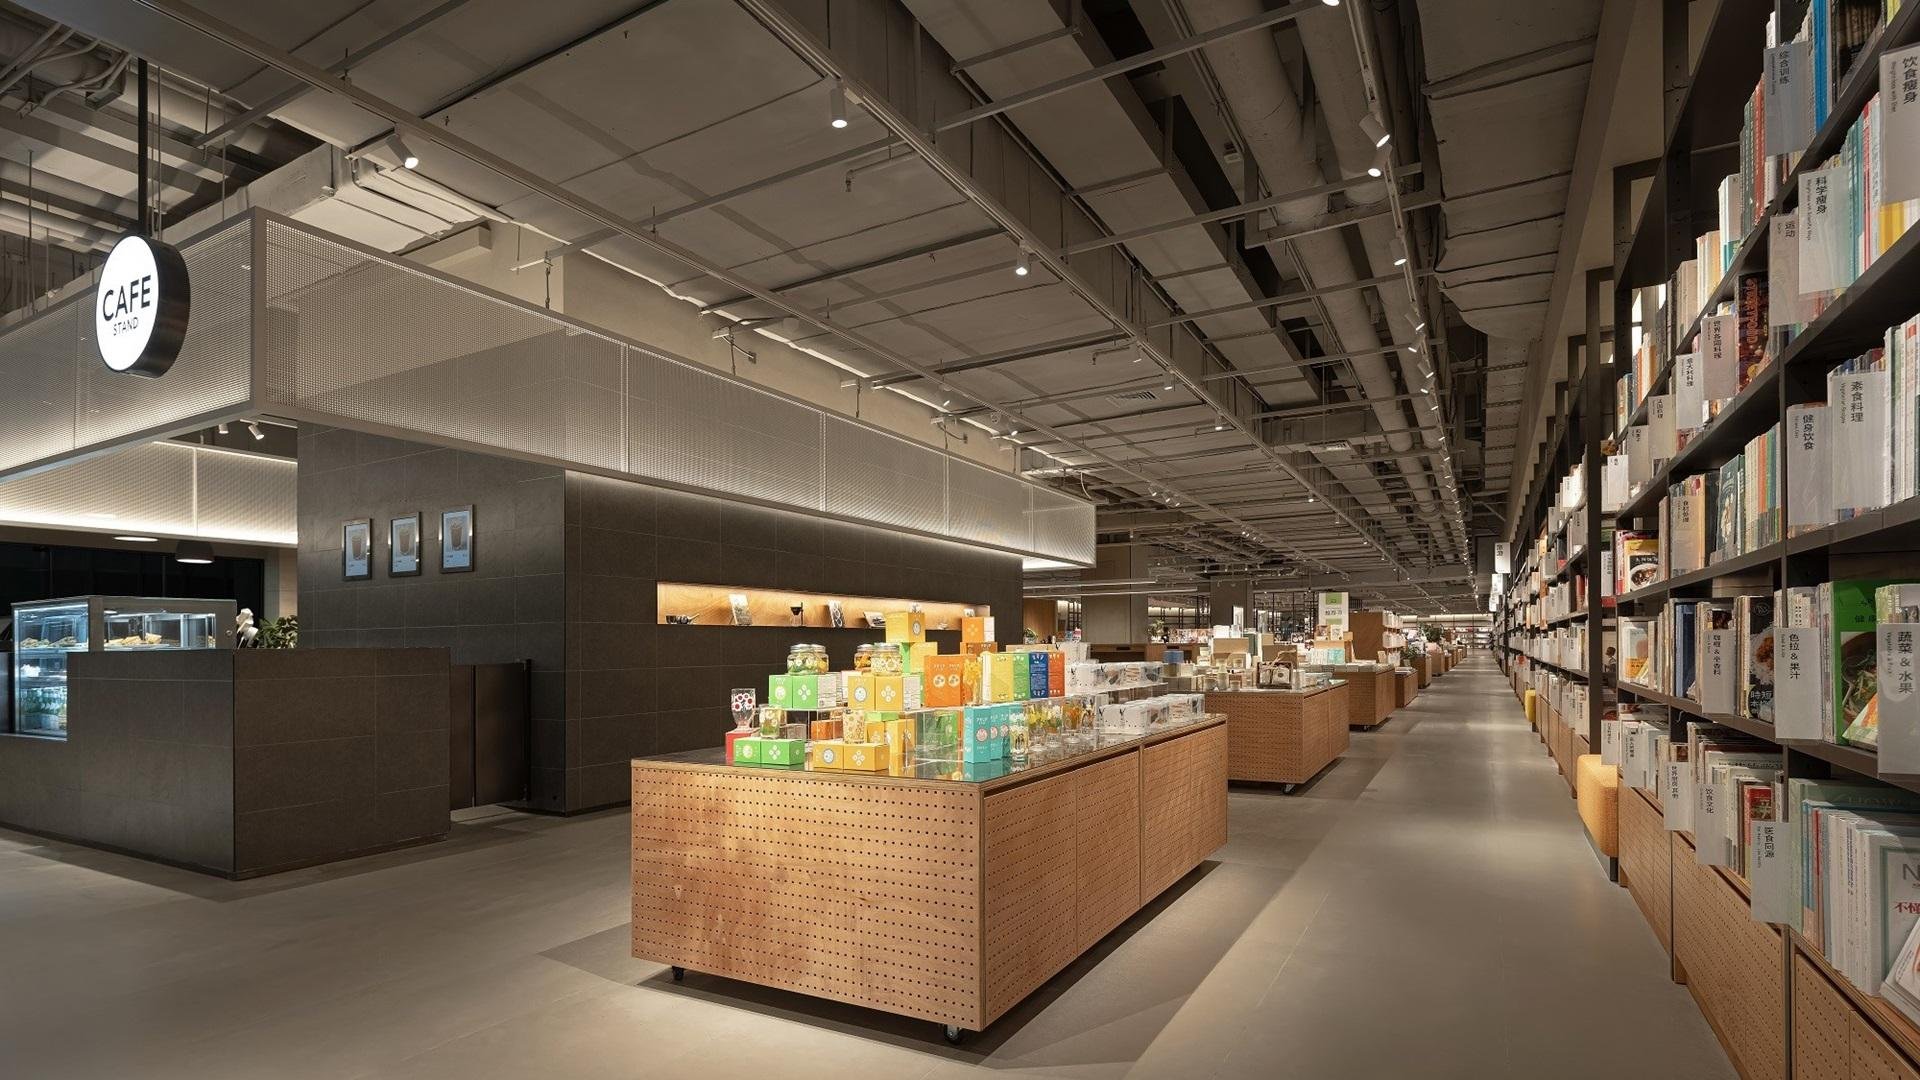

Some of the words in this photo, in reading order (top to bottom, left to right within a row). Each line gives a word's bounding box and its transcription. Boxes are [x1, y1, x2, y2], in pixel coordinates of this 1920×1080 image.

[1902, 56, 1918, 105] 饮食瘦身
[1815, 175, 1828, 215] 科学瘦身
[1785, 221, 1795, 237] 运动
[103, 275, 151, 321] CAFE
[113, 317, 139, 336] STAND
[1850, 380, 1864, 422] 素食料理
[1803, 414, 1815, 450] 健身饮食
[1902, 863, 1920, 882] N
